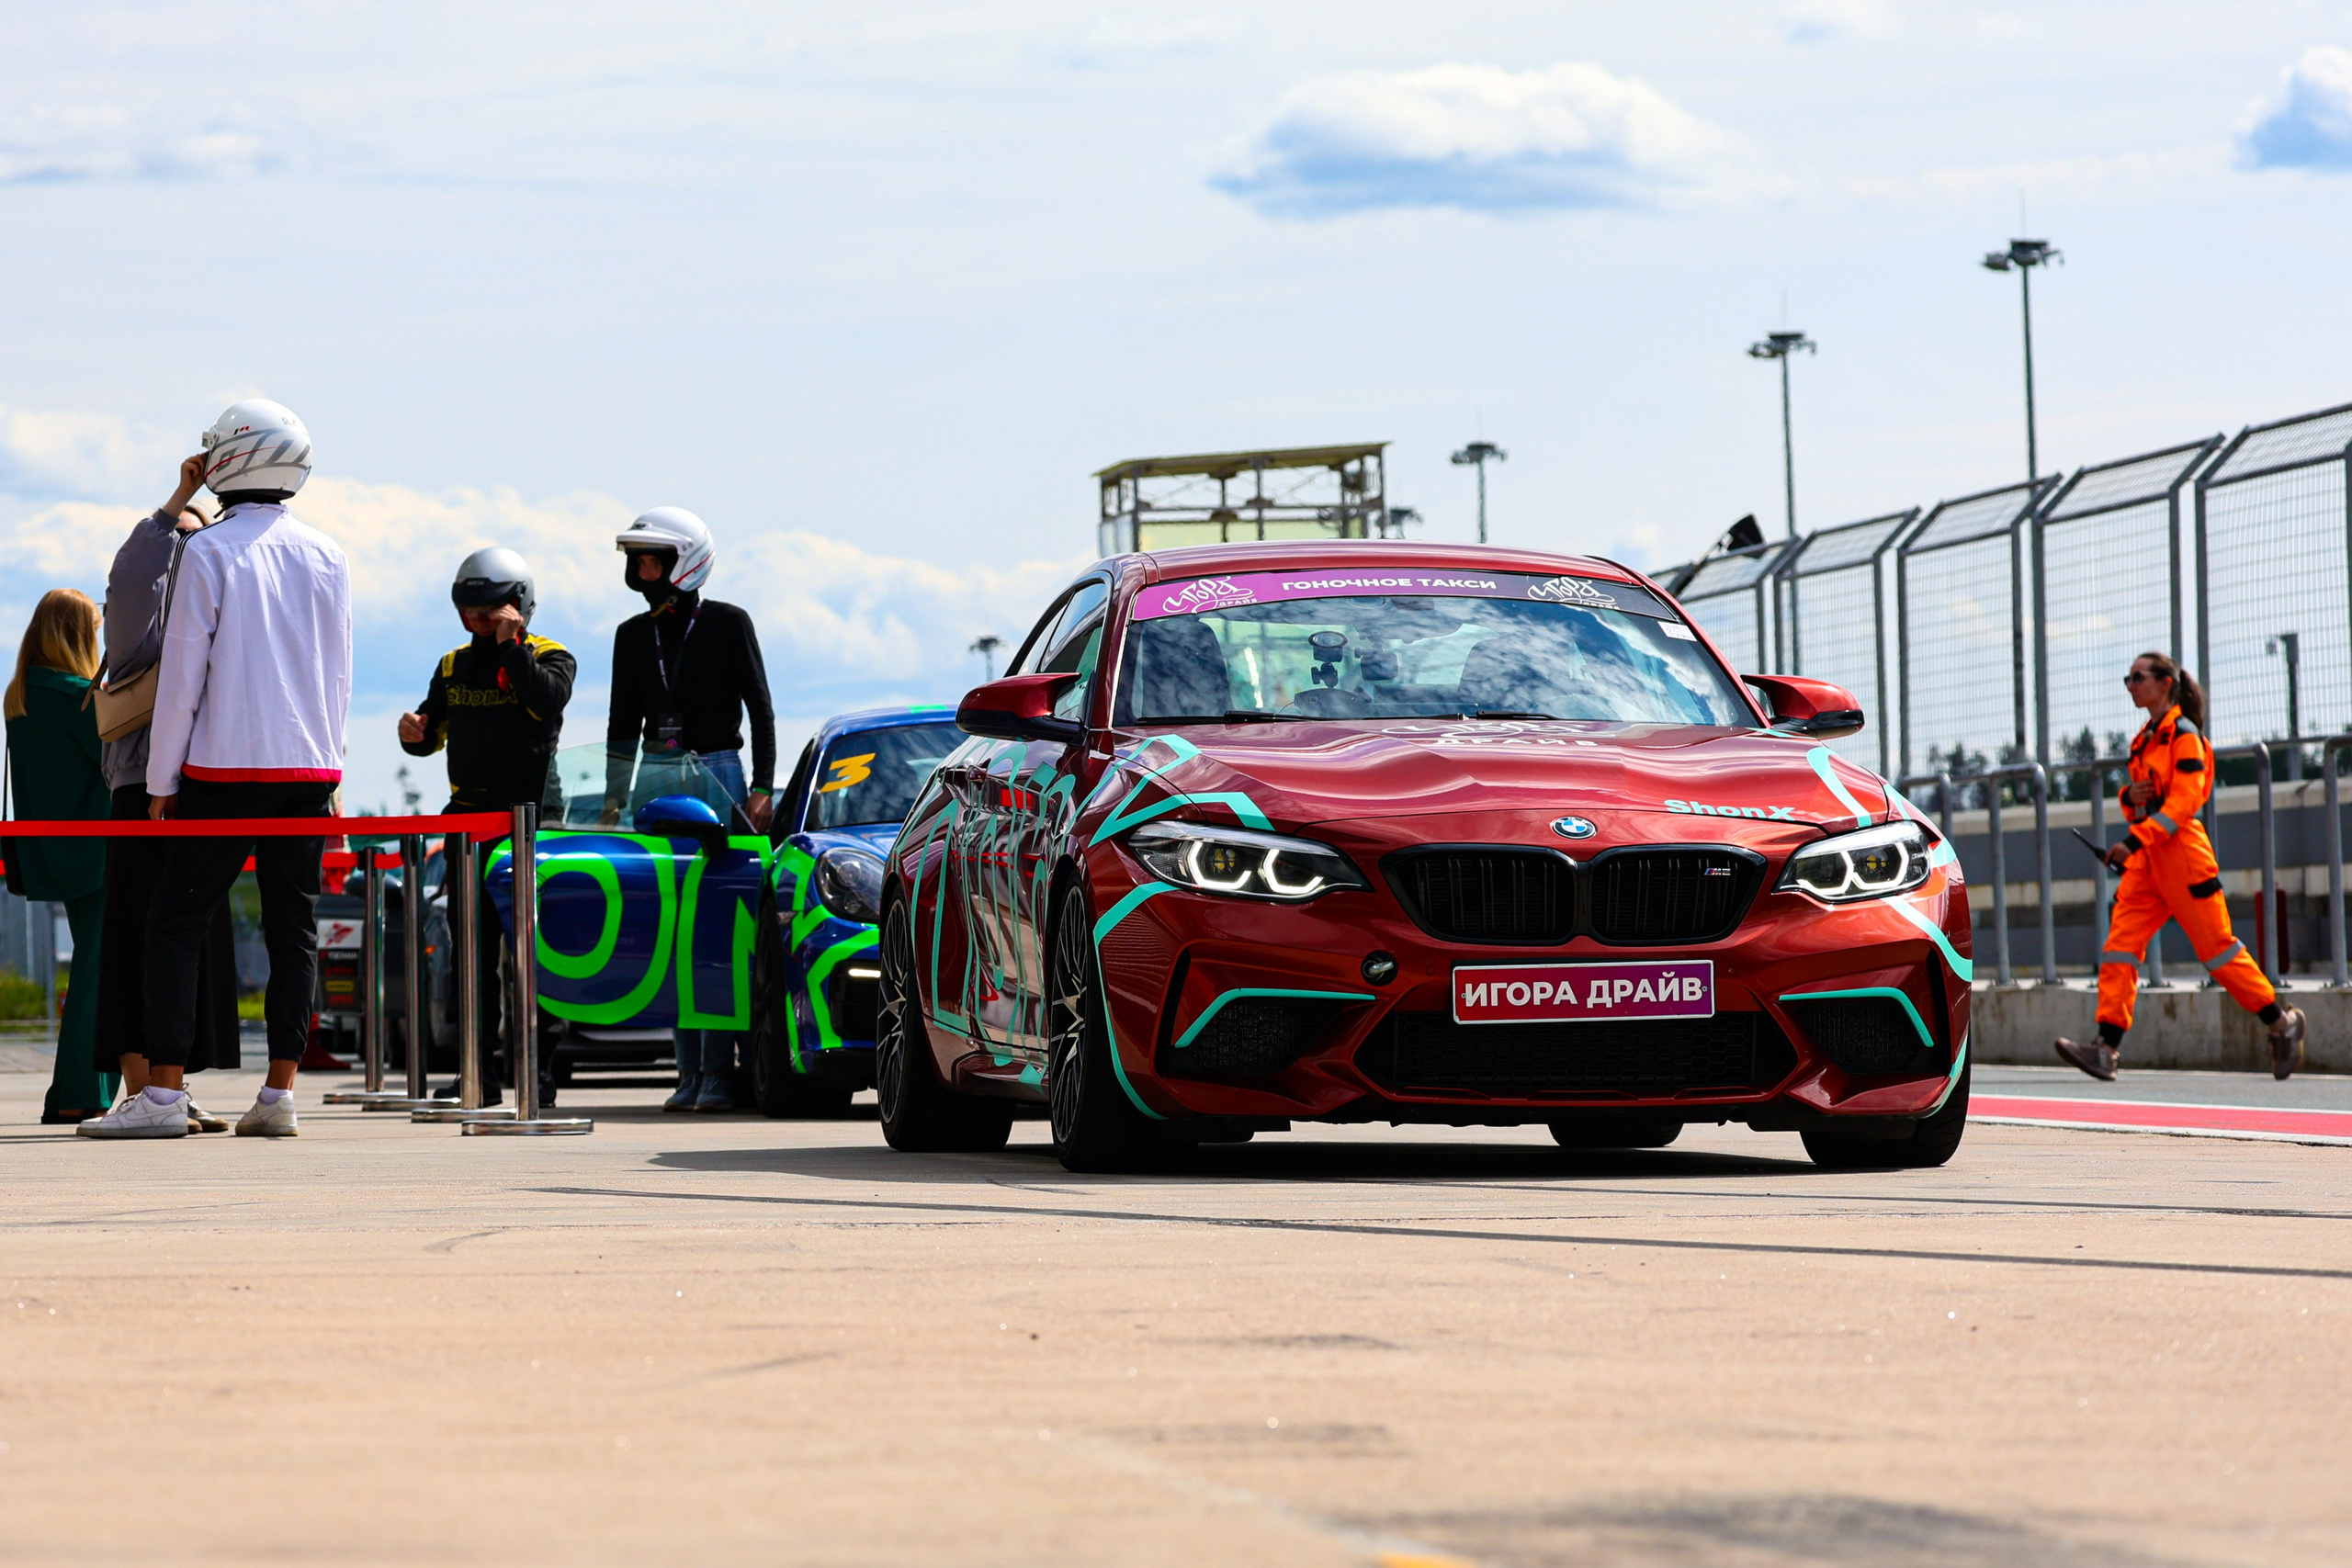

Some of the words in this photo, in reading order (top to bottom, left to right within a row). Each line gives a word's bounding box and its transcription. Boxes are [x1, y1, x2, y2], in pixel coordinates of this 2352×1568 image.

[1282, 578, 1413, 591] ГОНОЧНОЕ
[1417, 578, 1497, 590] ТАКСИ
[820, 752, 876, 793] 3
[1464, 980, 1577, 1007] ИГОРА
[1586, 971, 1703, 1009] ДРАЙВ
